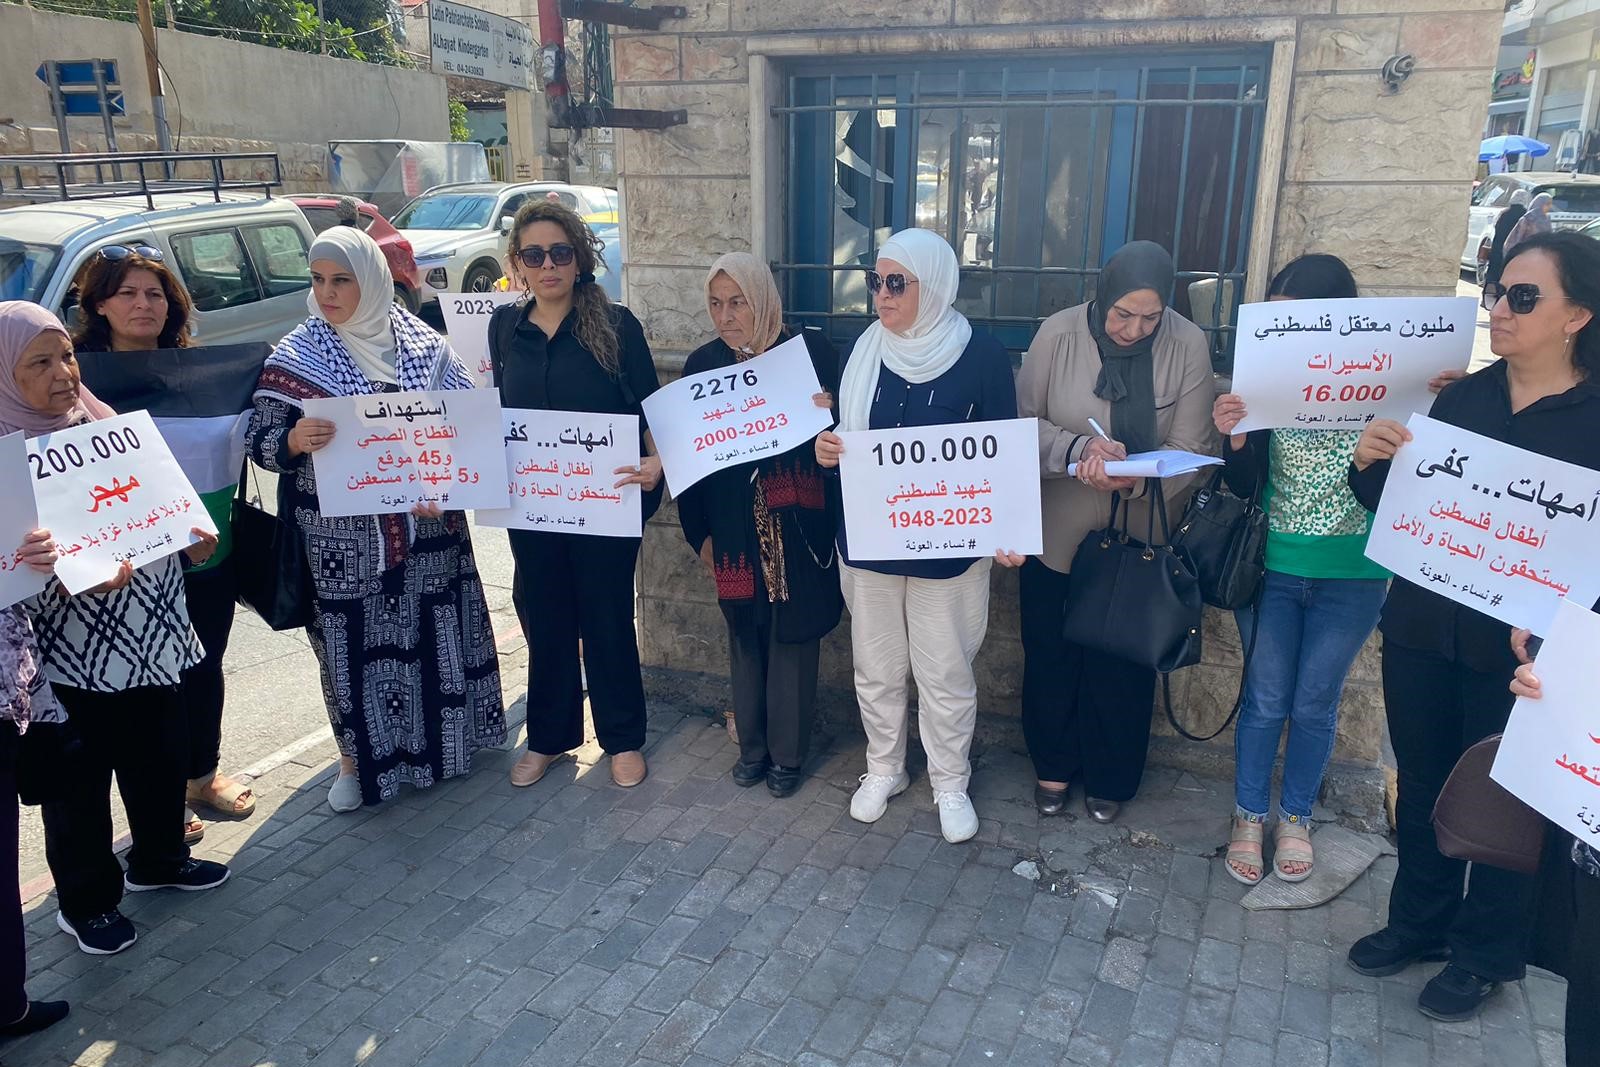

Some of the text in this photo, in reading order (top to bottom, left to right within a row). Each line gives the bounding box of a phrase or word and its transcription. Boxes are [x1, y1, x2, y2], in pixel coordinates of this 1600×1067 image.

[431, 4, 445, 22] Latin
[445, 7, 474, 29] Patriarchate
[457, 37, 489, 59] Kindergarten
[454, 300, 494, 315] 2023
[1254, 313, 1455, 341] مليون معتقل فلسطيني
[690, 369, 759, 401] 2276
[1301, 384, 1387, 402] 16.000
[702, 395, 766, 421] طفل شهيد
[356, 426, 458, 449] القطاع الصحي
[693, 412, 789, 452] 2000-2023
[28, 426, 141, 480] 200.000
[376, 451, 413, 471] موقع
[872, 434, 998, 466] 100.000
[515, 459, 559, 476] فلسطين
[1415, 448, 1470, 479] كفى
[346, 474, 402, 491] مسعفين
[408, 470, 452, 486] شهداء
[86, 474, 141, 513] مهجر
[530, 483, 562, 499] الحياة
[567, 486, 621, 503] يستحقون
[886, 479, 993, 506] شهيد فلسطيني
[174, 495, 192, 513] غزة
[127, 509, 160, 532] كهرباء
[888, 506, 993, 529] 1948-2023
[1429, 500, 1492, 533] فلسطين
[101, 522, 122, 541] غزة
[1438, 531, 1486, 561] الحياة
[1489, 555, 1571, 597] يستحقون
[1555, 753, 1600, 787] تعمد
